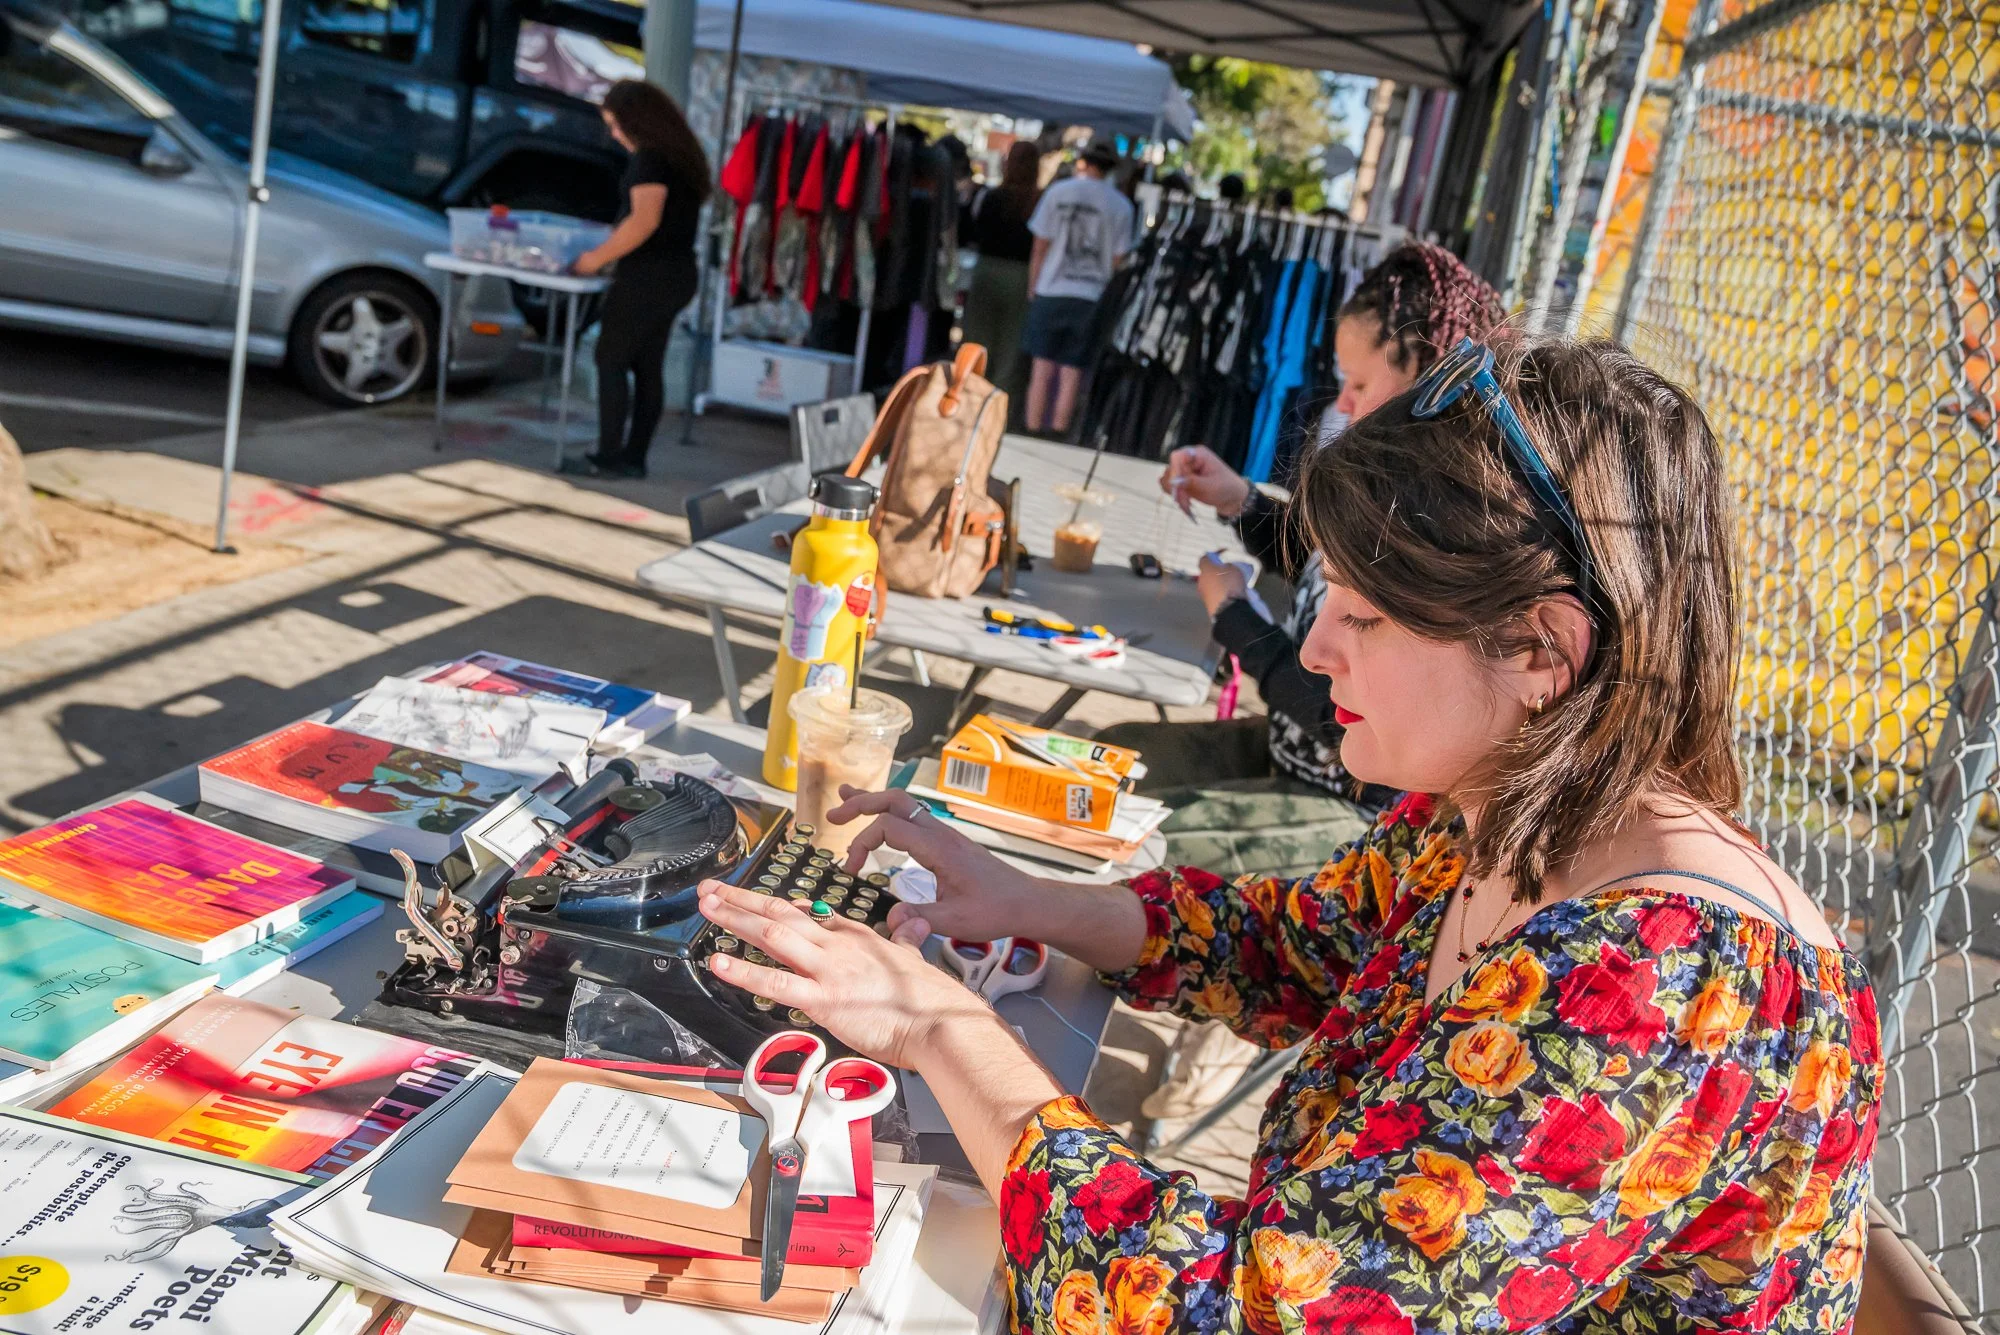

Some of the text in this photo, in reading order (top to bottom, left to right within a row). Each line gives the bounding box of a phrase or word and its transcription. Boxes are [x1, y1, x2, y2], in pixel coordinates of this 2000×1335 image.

[10, 959, 145, 1022] POSTALES
[123, 1047, 172, 1083] ALEJANDRA
[144, 1047, 191, 1082] PINTADO
[240, 1041, 344, 1096] EYE
[77, 1083, 125, 1117] QUINTANA
[97, 1084, 145, 1117] BURGOS
[200, 1094, 289, 1132] IN
[593, 1121, 607, 1138] learn
[600, 1142, 614, 1159] learn
[616, 1111, 632, 1132] believe
[625, 1121, 644, 1150] surprised
[92, 1151, 118, 1169] the
[55, 1155, 132, 1223] contemplate
[790, 1242, 816, 1253] rima
[129, 1264, 217, 1331] Poets
[179, 1244, 273, 1323] Miami
